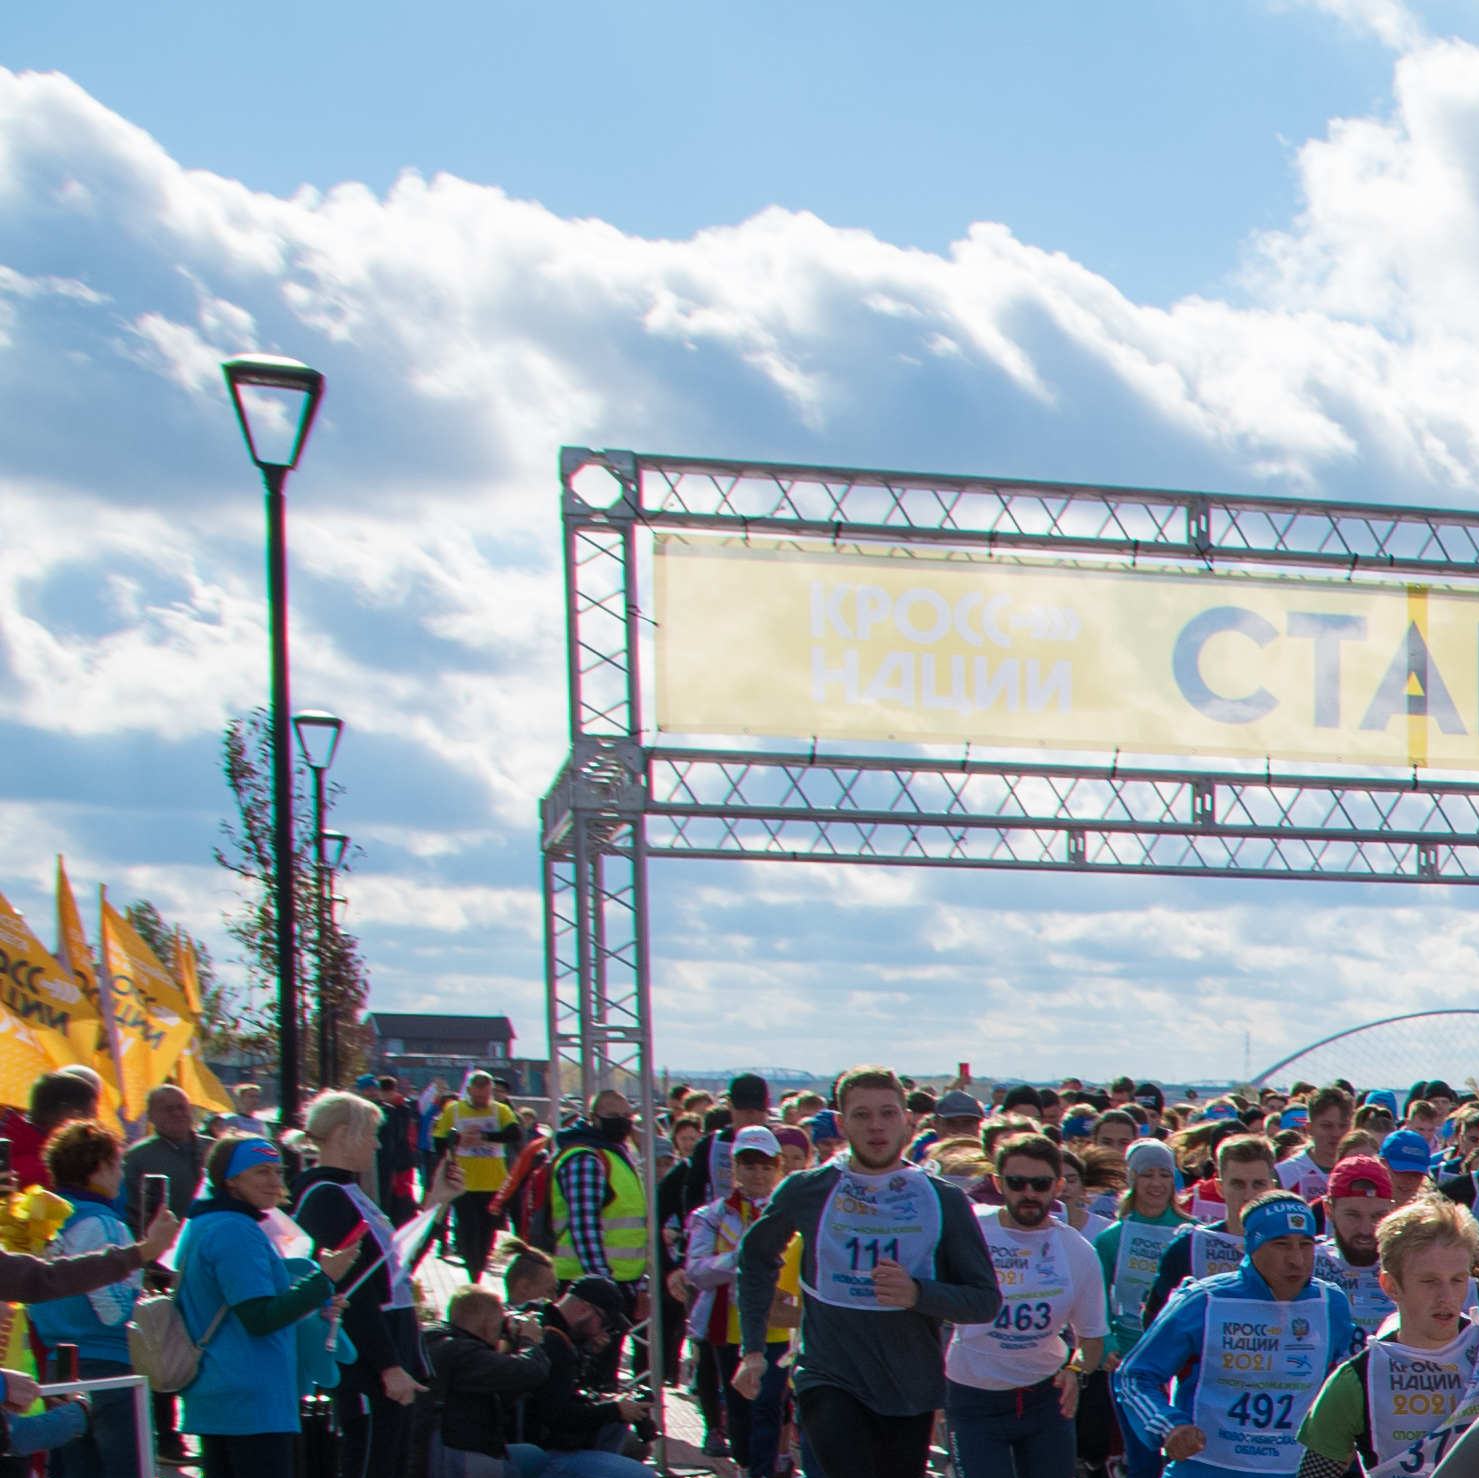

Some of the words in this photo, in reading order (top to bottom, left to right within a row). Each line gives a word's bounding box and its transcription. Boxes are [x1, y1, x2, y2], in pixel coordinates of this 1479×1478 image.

[810, 581, 1012, 649] КРОСС
[810, 646, 1072, 718] НАЦИИ
[844, 1237, 899, 1270] 111
[994, 1302, 1052, 1331] 463
[1223, 1321, 1267, 1337] КРОСС
[1222, 1337, 1279, 1352] НАЦИИ
[1222, 1353, 1272, 1371] 2021
[1390, 1373, 1462, 1392] НАЦИИ
[1227, 1392, 1294, 1429] 492
[1393, 1393, 1456, 1415] 2021
